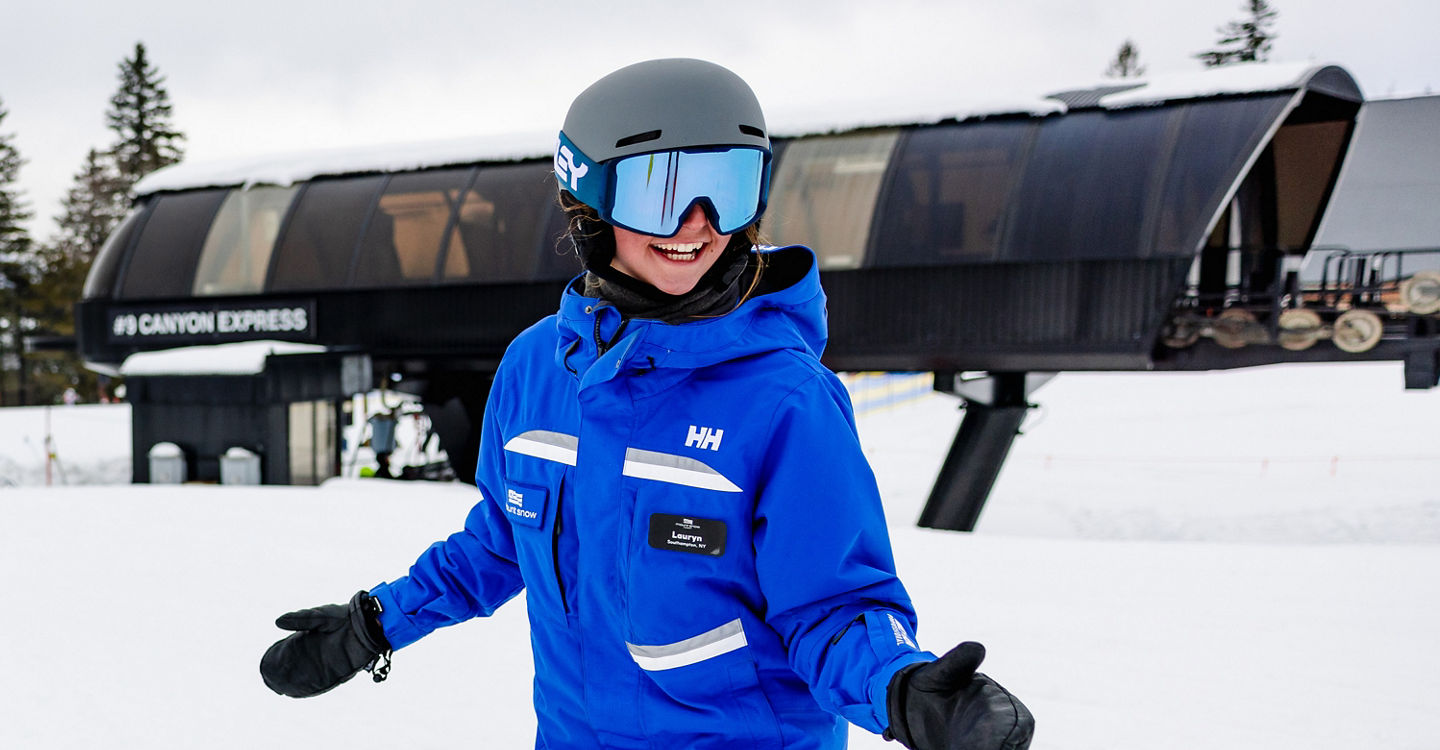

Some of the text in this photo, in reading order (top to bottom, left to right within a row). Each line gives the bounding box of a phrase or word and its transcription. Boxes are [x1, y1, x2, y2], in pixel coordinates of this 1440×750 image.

[113, 308, 308, 336] #9 CANYON EXPRESS
[684, 424, 724, 451] HH
[517, 508, 537, 519] snow
[671, 530, 703, 543] Lauryn
